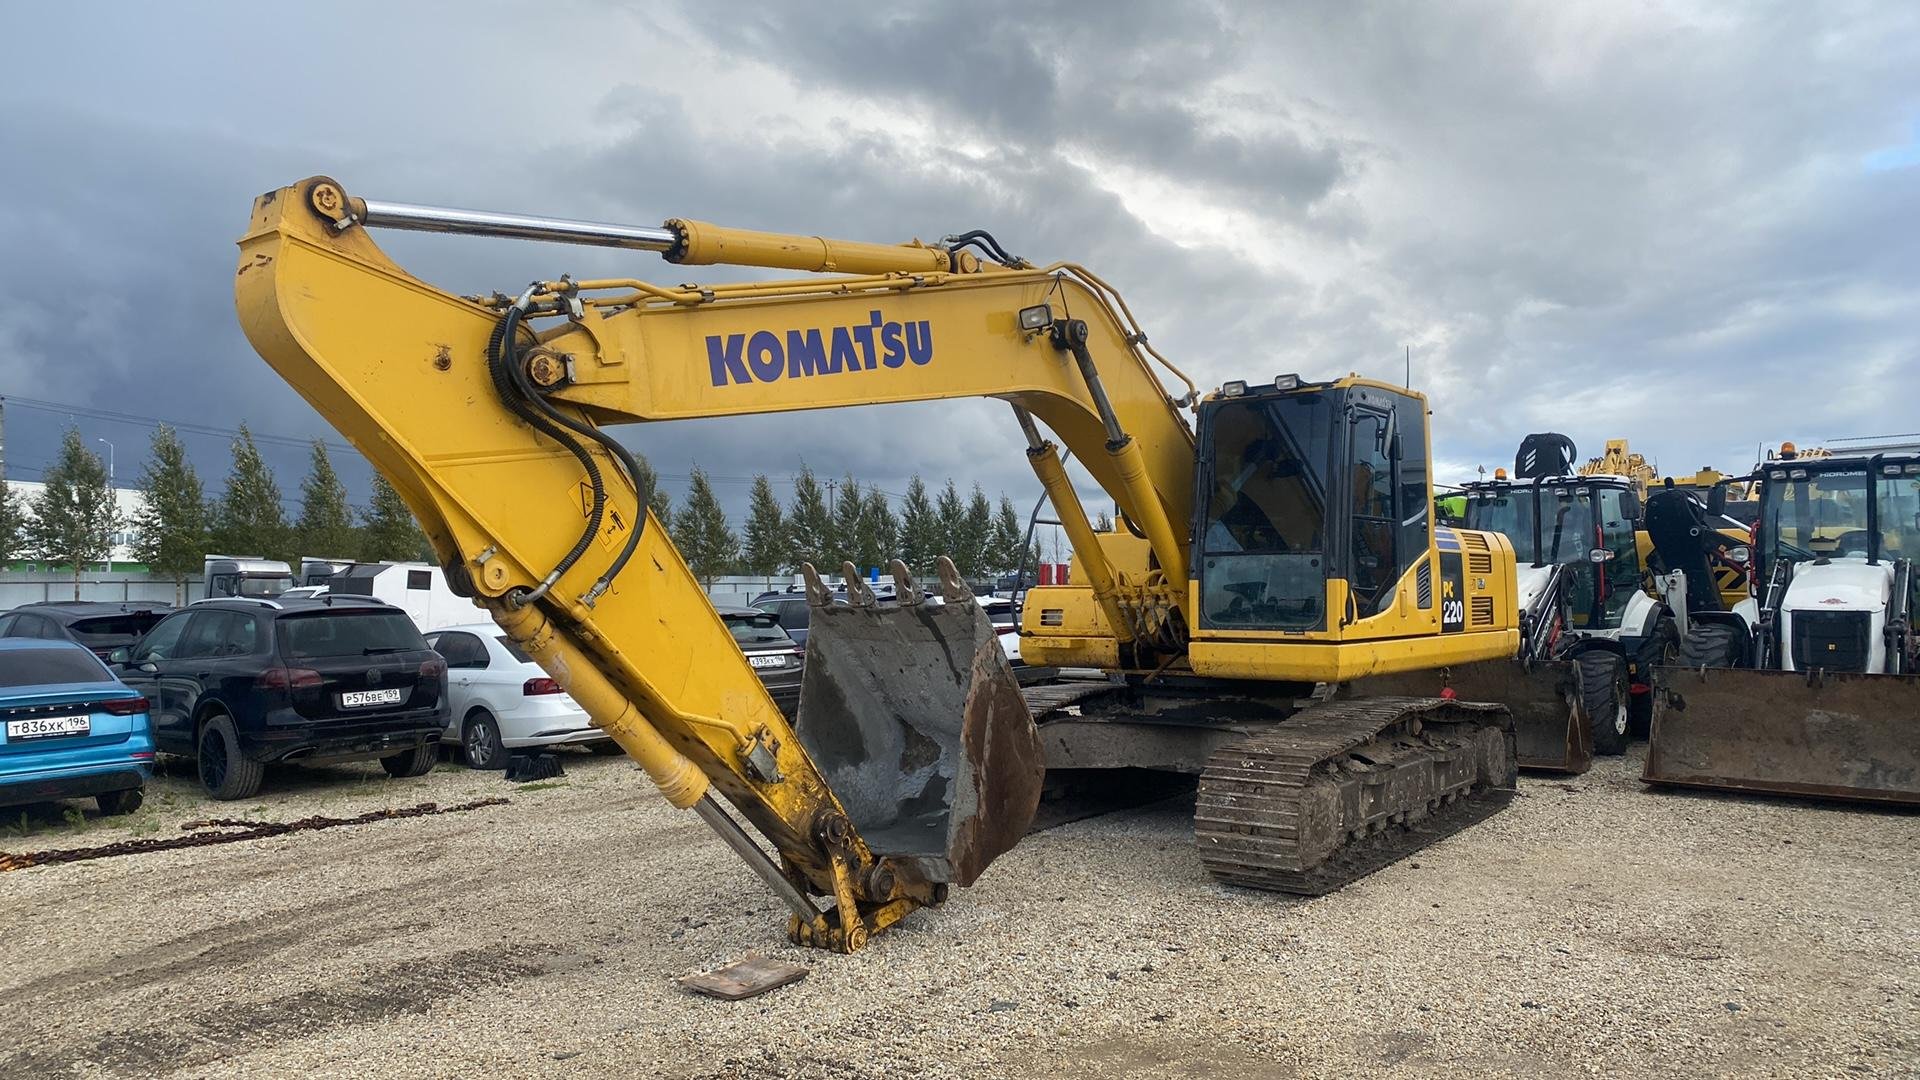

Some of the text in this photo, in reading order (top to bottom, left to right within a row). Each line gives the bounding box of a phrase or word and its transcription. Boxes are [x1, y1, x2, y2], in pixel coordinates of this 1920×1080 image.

[705, 310, 933, 387] KOMATSU
[1443, 581, 1454, 598] PC
[1443, 600, 1463, 623] 220
